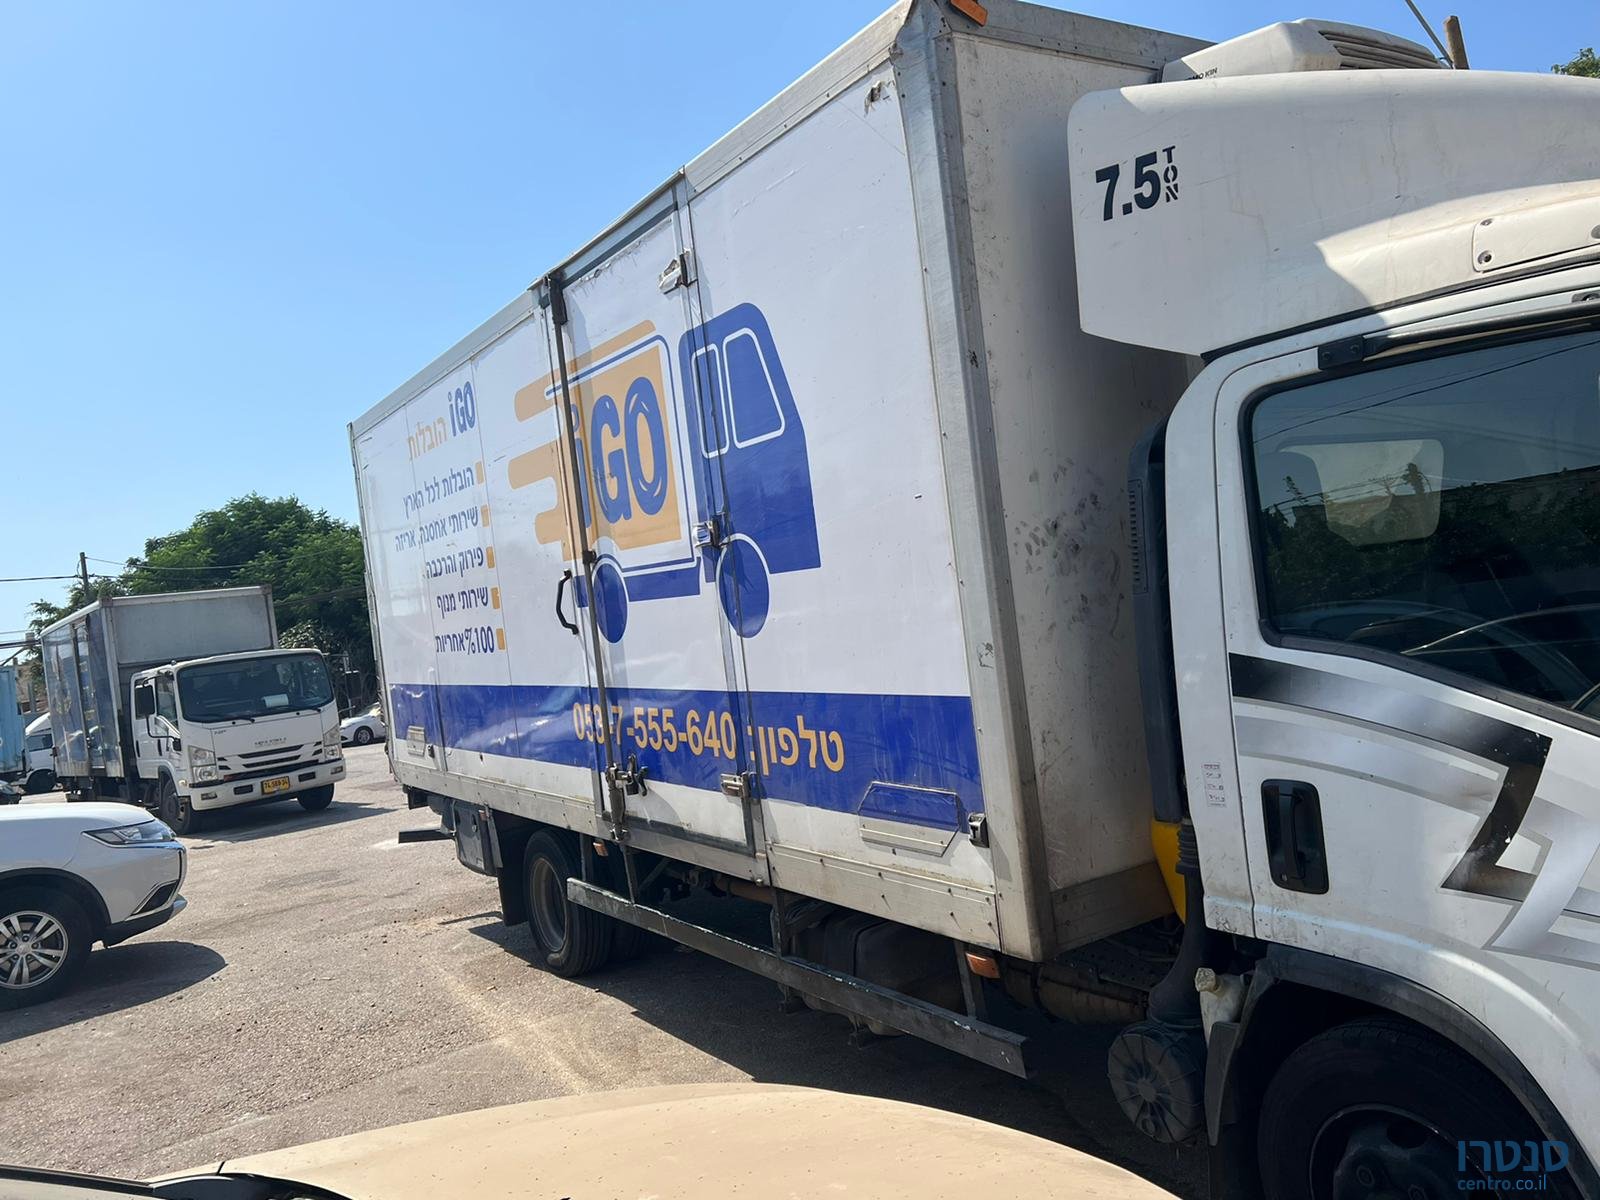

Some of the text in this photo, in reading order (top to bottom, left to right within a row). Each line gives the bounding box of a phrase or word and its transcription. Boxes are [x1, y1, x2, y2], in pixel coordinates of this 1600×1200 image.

[1095, 145, 1179, 221] 7.5 TON
[407, 381, 476, 462] iGO הובלות
[571, 376, 668, 529] iGO
[403, 467, 475, 520] הובלות לכל הארץ
[448, 506, 479, 535] שירותי
[458, 546, 485, 578] פירוק
[436, 586, 489, 620] שירותי מנוף
